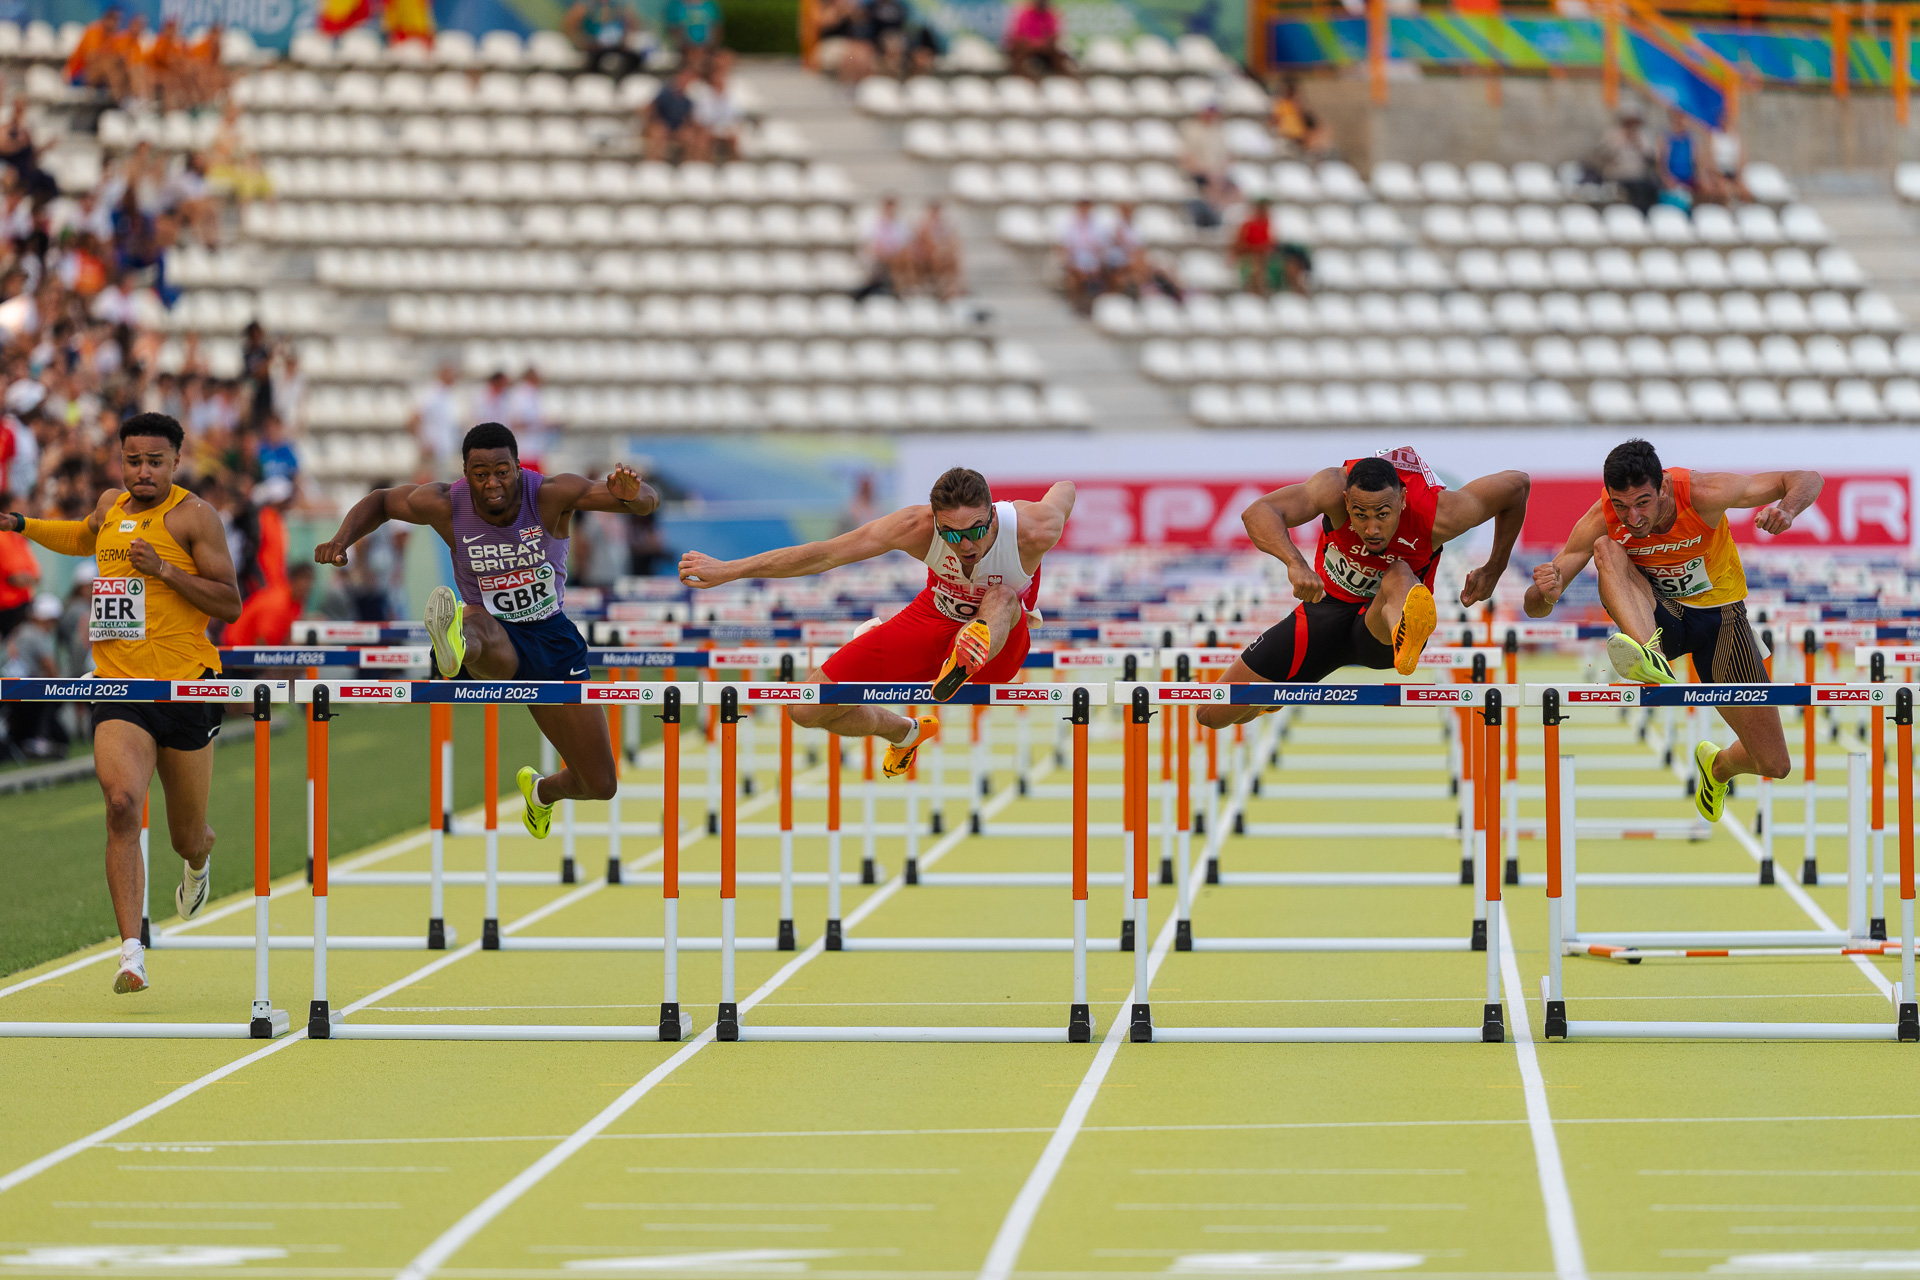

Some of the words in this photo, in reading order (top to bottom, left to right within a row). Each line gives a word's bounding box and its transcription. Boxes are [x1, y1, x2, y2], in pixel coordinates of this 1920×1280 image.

[467, 538, 541, 559] GREAT
[99, 548, 131, 562] GERMA
[470, 549, 546, 572] BRITAIN
[1335, 557, 1378, 591] SUI
[481, 571, 534, 590] SPAR
[92, 581, 125, 593] PAR
[492, 582, 550, 613] GBR
[93, 598, 137, 620] GER
[118, 630, 140, 639] 2025
[45, 684, 93, 696] Madrid
[95, 685, 129, 696] 2025
[188, 687, 229, 695] SPAR
[351, 688, 392, 696] SPAR
[455, 687, 502, 699] Madrid
[504, 688, 539, 699] 2025
[599, 690, 639, 698] SPAR
[760, 689, 800, 698] SPAR
[863, 688, 911, 700] Madrid
[1008, 690, 1048, 699] SPAR
[1170, 690, 1211, 698] SPAR
[1274, 689, 1322, 701] Madrid
[1323, 690, 1358, 701] 2025
[1418, 691, 1459, 699] SPAR
[1684, 690, 1732, 702] Madrid
[1733, 691, 1769, 702] 2025
[1829, 691, 1869, 699] SPAR
[1580, 692, 1621, 701] SPAR
